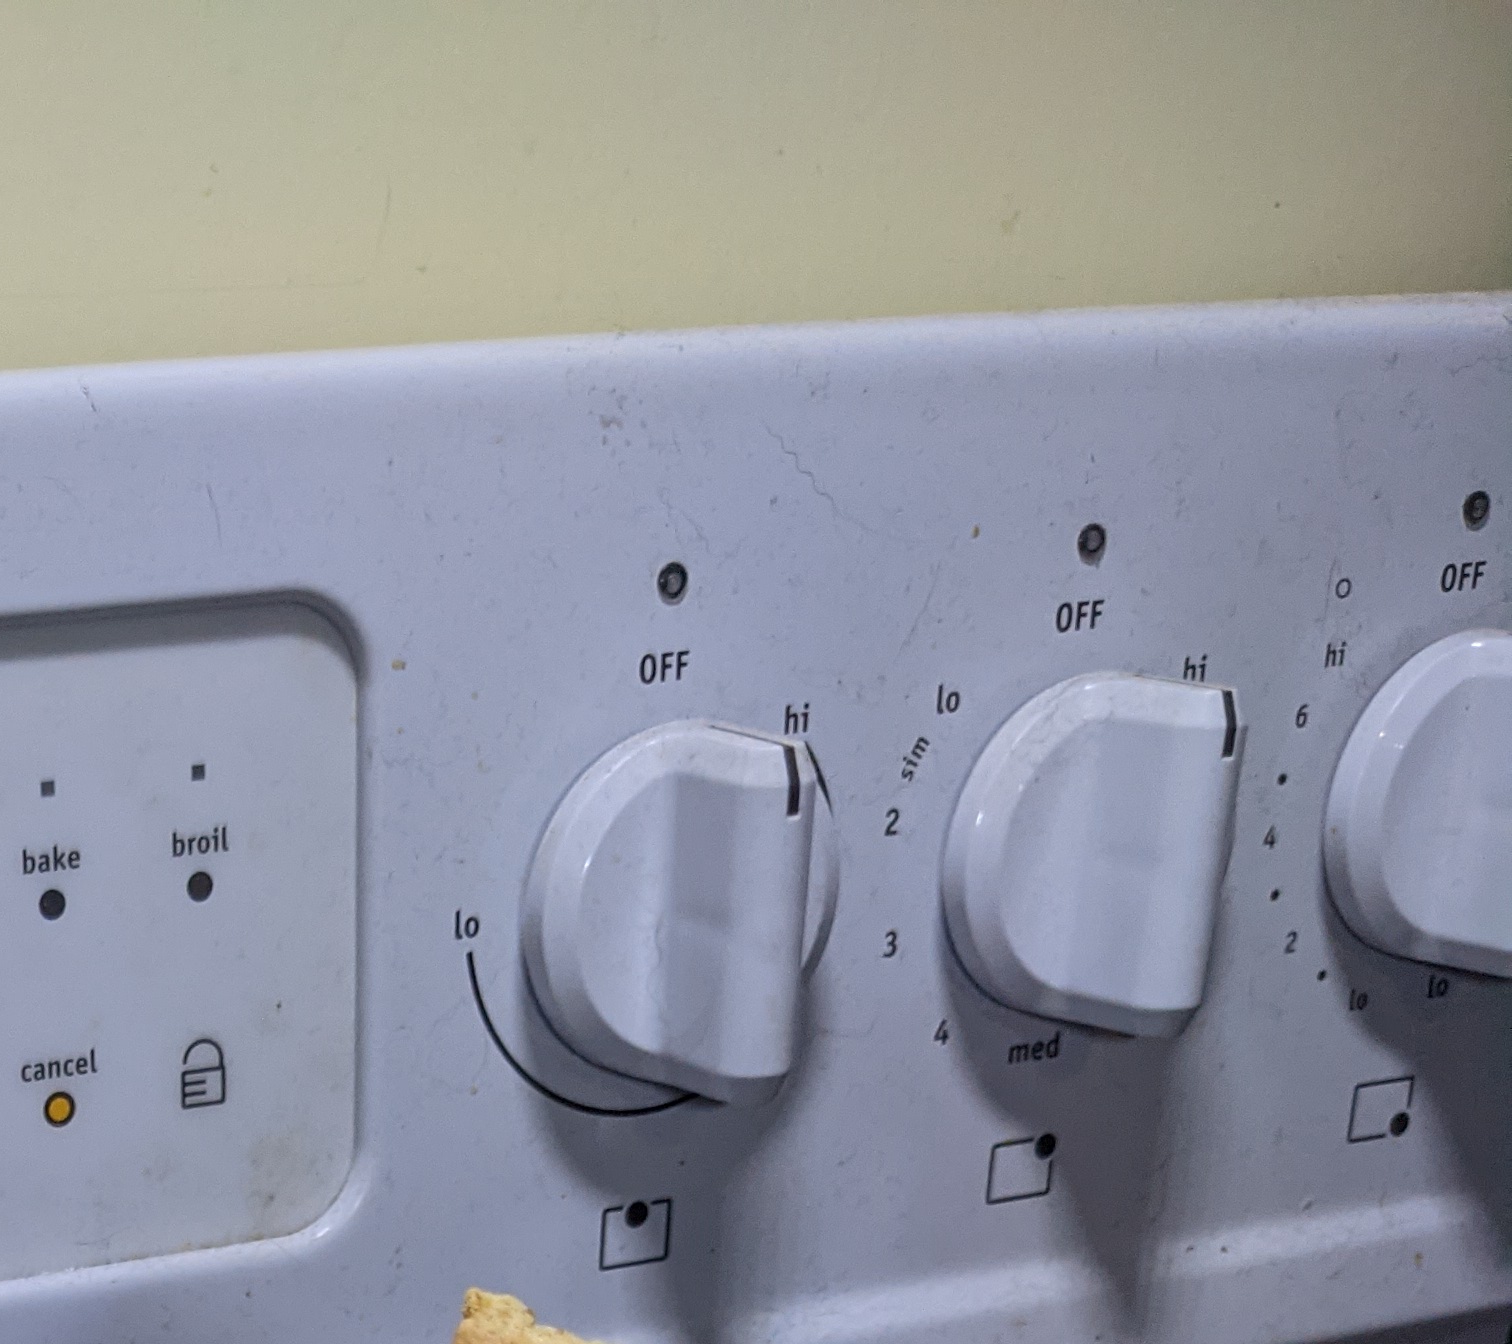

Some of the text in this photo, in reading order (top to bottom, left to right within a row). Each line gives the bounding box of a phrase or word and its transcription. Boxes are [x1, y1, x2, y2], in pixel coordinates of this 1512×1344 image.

[1440, 560, 1488, 593] OFF
[1055, 599, 1105, 633] OFF
[639, 650, 690, 685] OFF
[1182, 654, 1208, 683] hi
[1324, 641, 1347, 668] hi
[936, 683, 961, 715] lo
[784, 702, 810, 735] hi
[1295, 703, 1308, 729] 6
[901, 736, 930, 782] sim
[884, 807, 900, 837] 2
[1263, 826, 1277, 849] 4
[171, 825, 229, 858] broil
[22, 844, 81, 875] bake
[454, 909, 480, 940] lo
[882, 930, 898, 959] 3
[1284, 930, 1298, 954] 2
[1348, 988, 1369, 1012] lo
[1426, 972, 1449, 999] lo
[933, 1019, 949, 1046] 4
[1007, 1030, 1061, 1064] med
[20, 1048, 98, 1083] cancel
